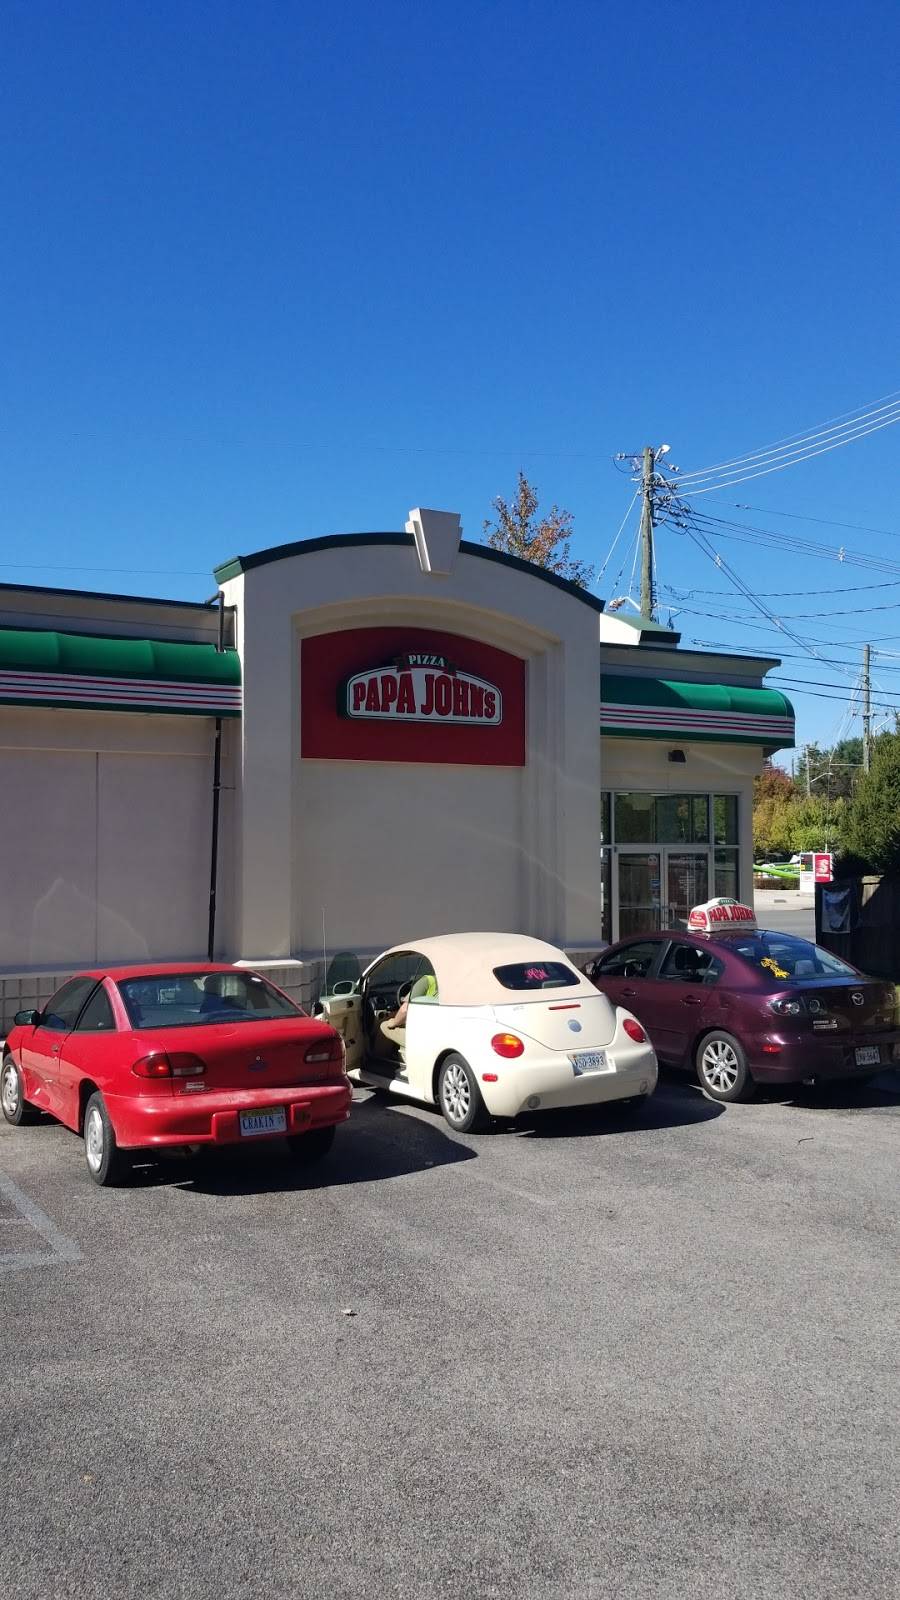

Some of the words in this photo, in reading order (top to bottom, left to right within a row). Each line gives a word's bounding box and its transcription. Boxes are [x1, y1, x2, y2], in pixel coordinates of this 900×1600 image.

[408, 654, 445, 667] PIZZA
[353, 673, 416, 713] PAPA
[420, 674, 496, 719] JOHN'S
[708, 906, 730, 921] PAPA
